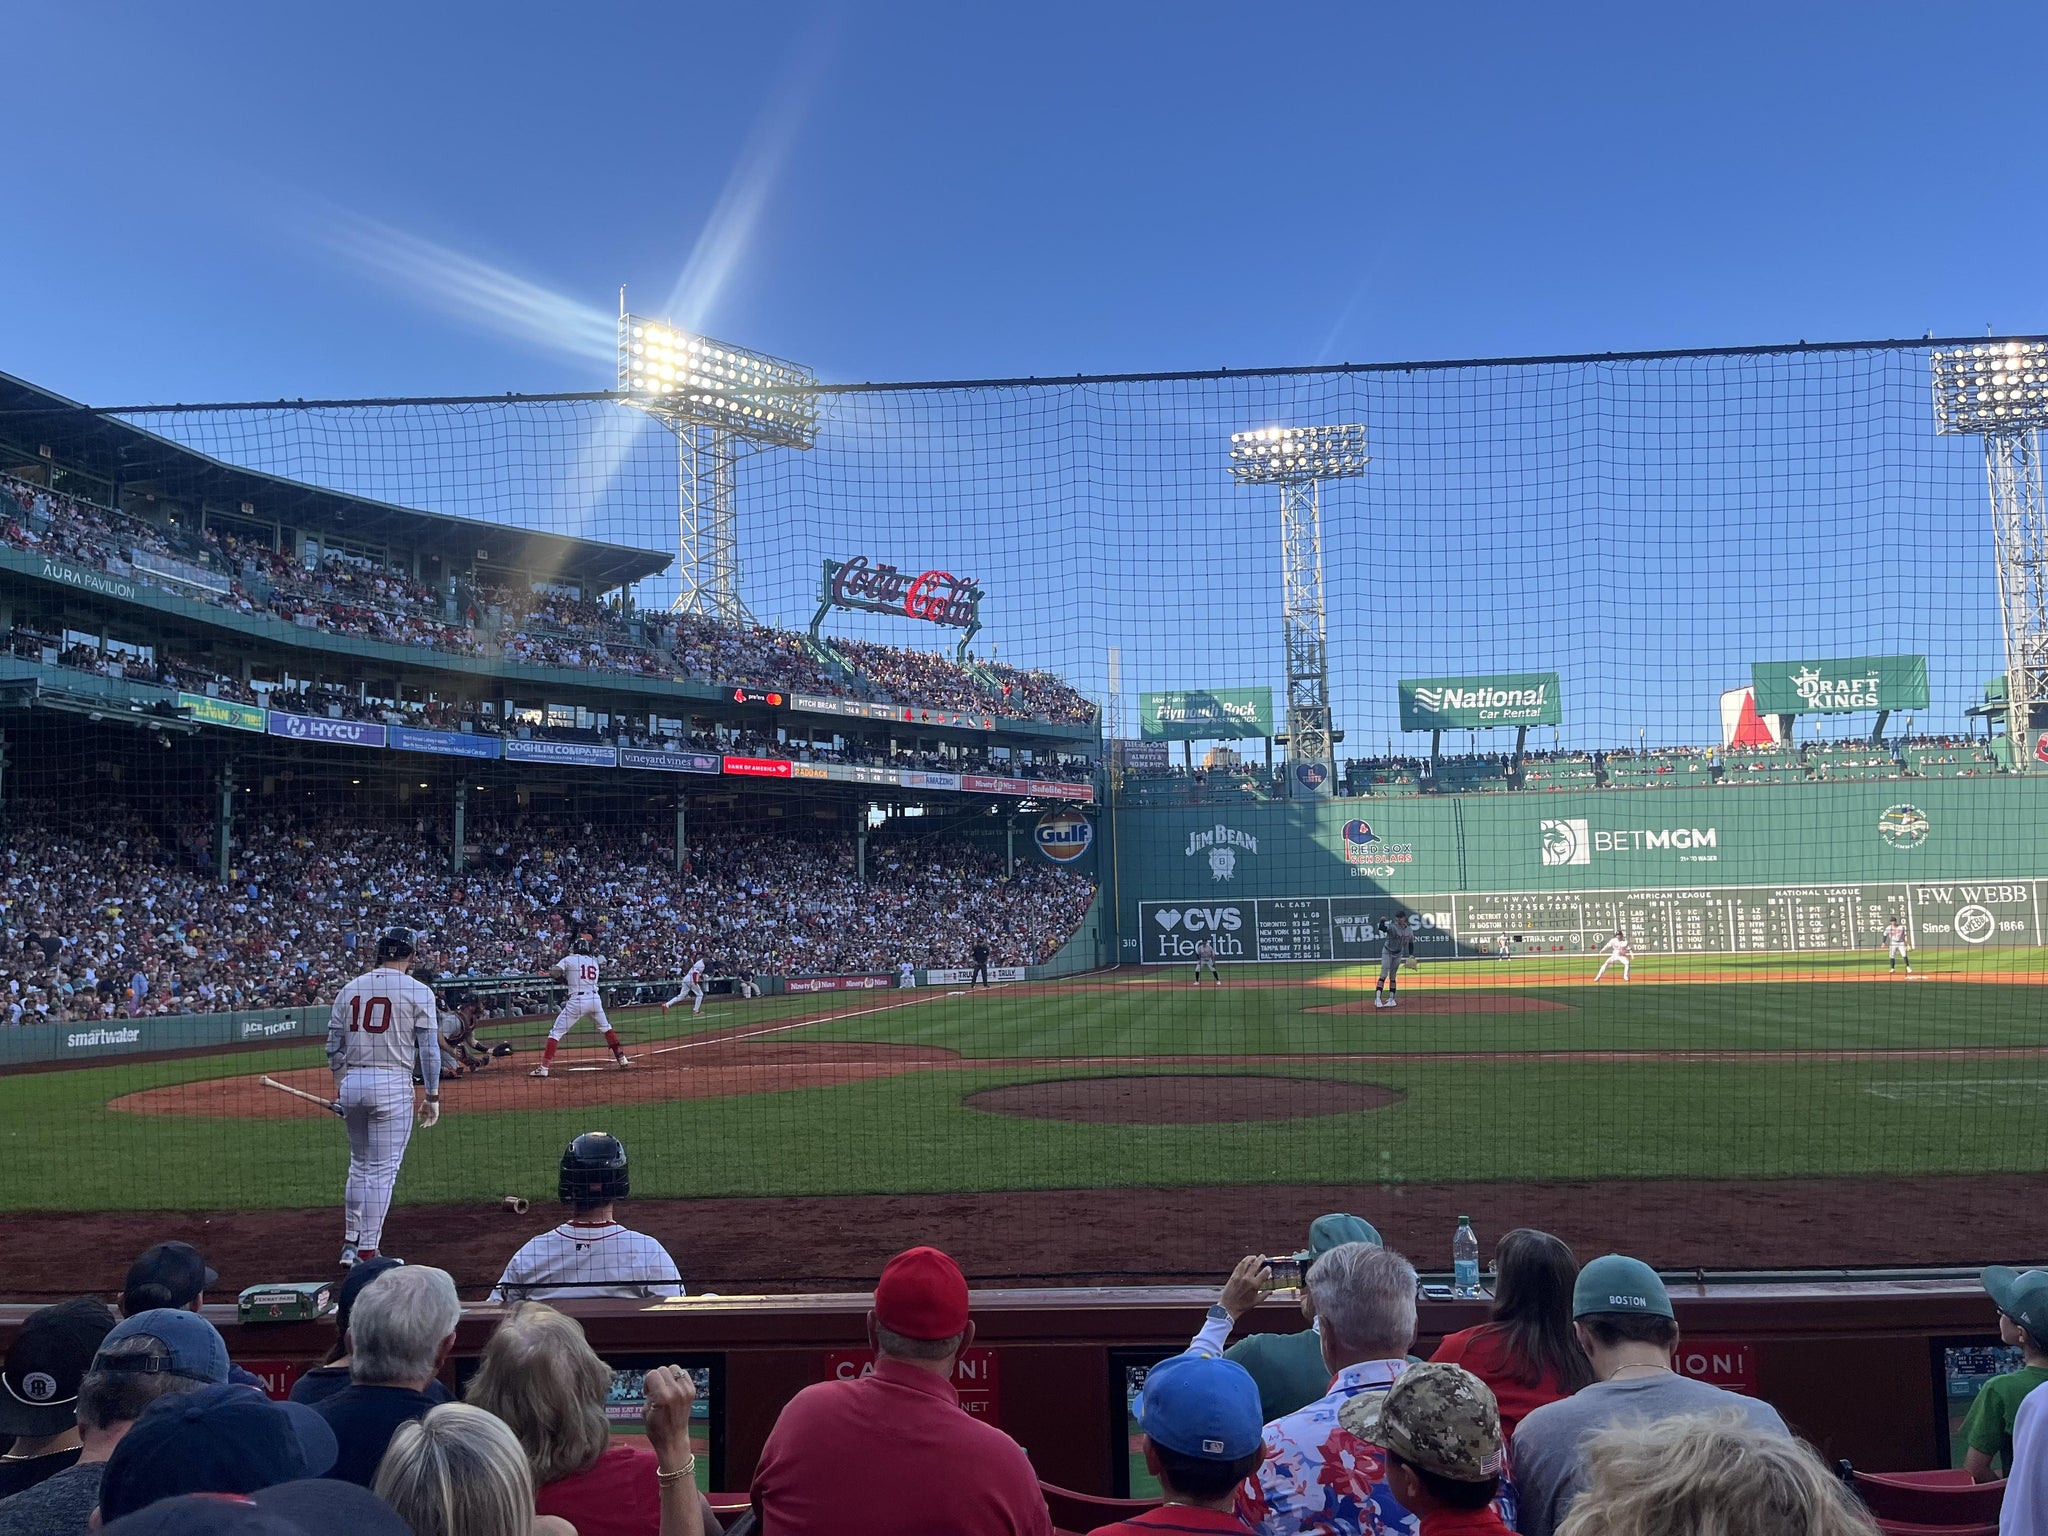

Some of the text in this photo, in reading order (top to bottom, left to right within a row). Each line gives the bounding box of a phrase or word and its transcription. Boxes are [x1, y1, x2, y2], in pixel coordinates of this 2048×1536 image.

[85, 574, 135, 599] PAVILION
[1797, 678, 1879, 697] DRAFT
[799, 699, 817, 708] PITCH
[817, 701, 837, 710] BREAK
[1808, 693, 1879, 709] KINGS
[1157, 701, 1257, 720] Plymouth Rock
[1479, 707, 1541, 719] Car Rental
[310, 721, 360, 740] HYCU
[507, 742, 615, 758] COGHLIN COMPANIES
[625, 754, 691, 767] vineyard vines
[751, 765, 776, 773] AMERICA
[1037, 825, 1088, 843] Gulf
[1185, 824, 1258, 856] JIM BEAM
[1594, 828, 1717, 851] BETMGM
[1351, 844, 1412, 855] RED SOX
[1351, 854, 1413, 864] SCHOLARS
[1351, 867, 1384, 877] BIDMC
[1960, 886, 2027, 903] WEBB
[1183, 907, 1242, 931] CVS
[1354, 916, 1369, 924] BUT
[1965, 916, 1985, 931] WEBB
[1341, 925, 1379, 942] W.B.
[1922, 921, 2025, 933] Since 1866
[1123, 938, 1137, 947] 310
[580, 964, 596, 981] 16
[790, 981, 811, 990] Ninety
[350, 996, 392, 1034] 10
[244, 1021, 297, 1036] ACE TICKET
[67, 1027, 139, 1047] smartwater
[1609, 1296, 1647, 1307] BOSTON
[960, 1401, 989, 1412] NET
